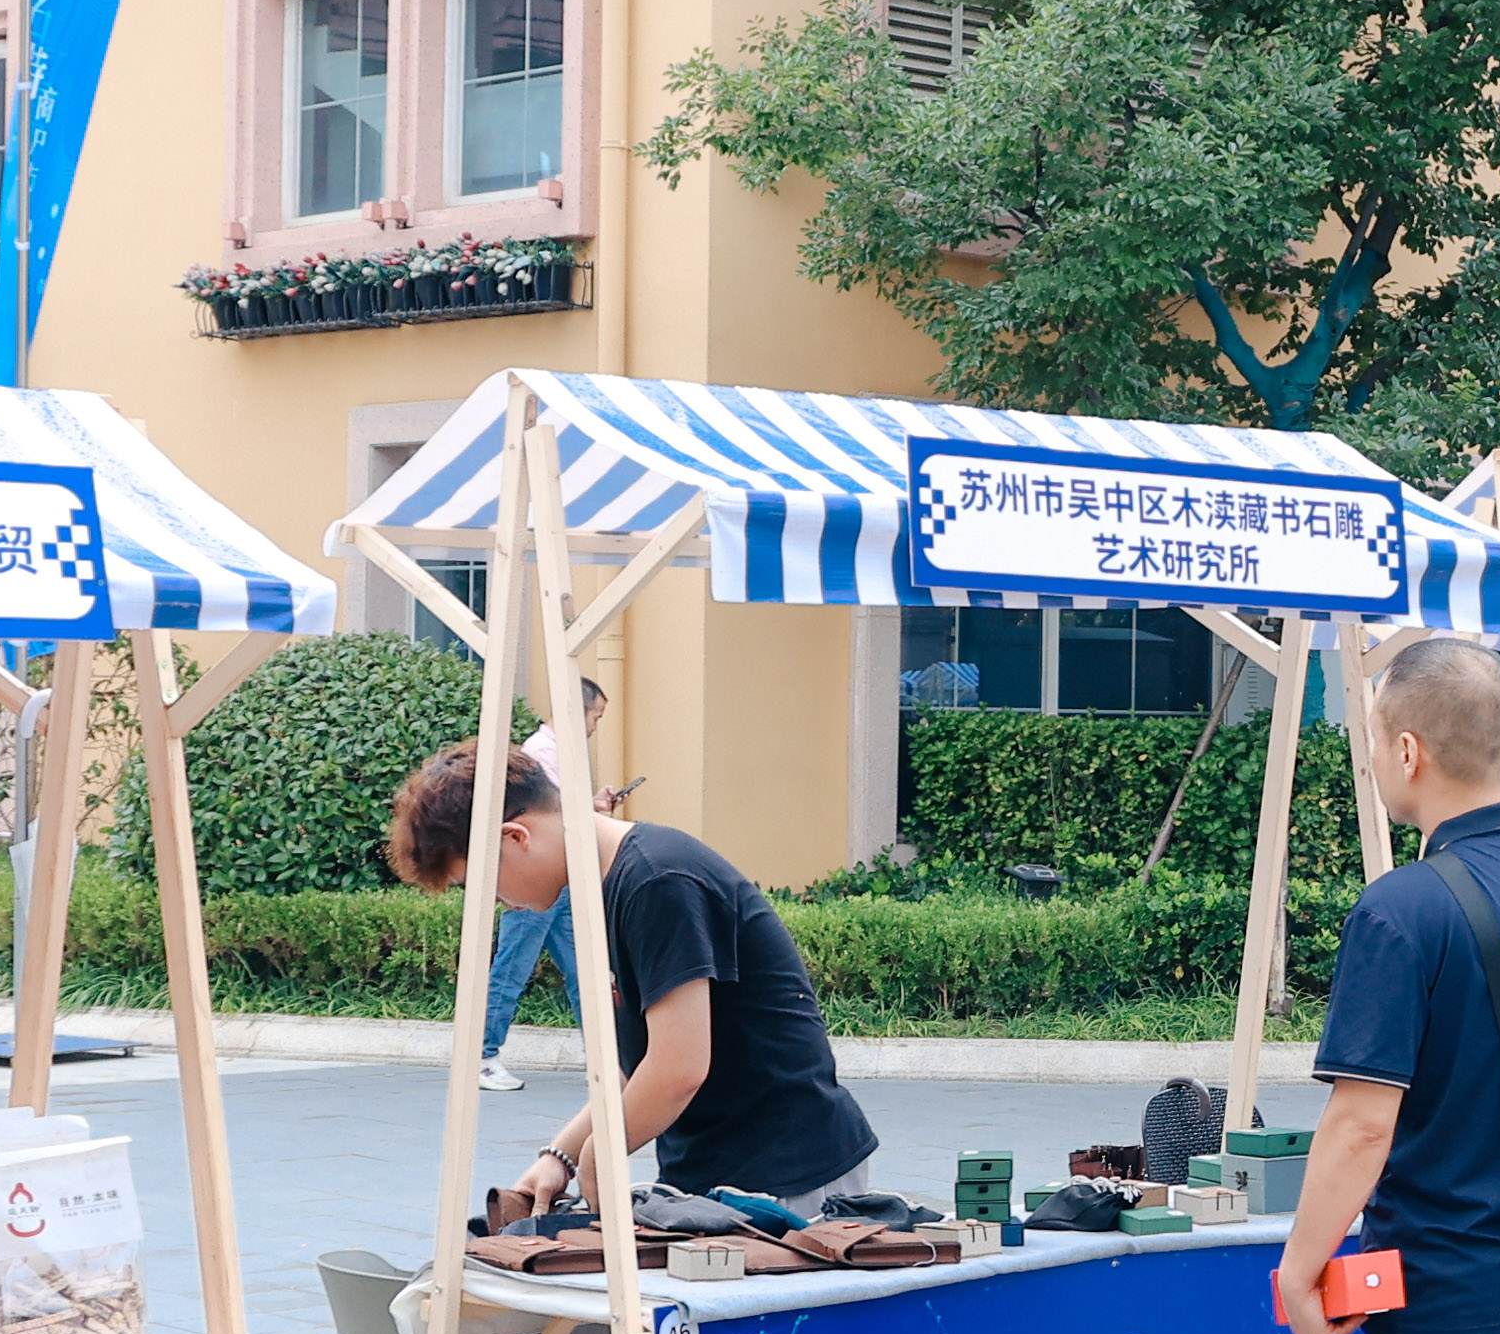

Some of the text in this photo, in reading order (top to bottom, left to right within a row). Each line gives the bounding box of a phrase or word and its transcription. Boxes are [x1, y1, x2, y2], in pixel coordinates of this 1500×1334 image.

[959, 468, 1366, 544] 苏州市吴中区木渎藏书石雕
[1092, 534, 1261, 586] 艺术研究所
